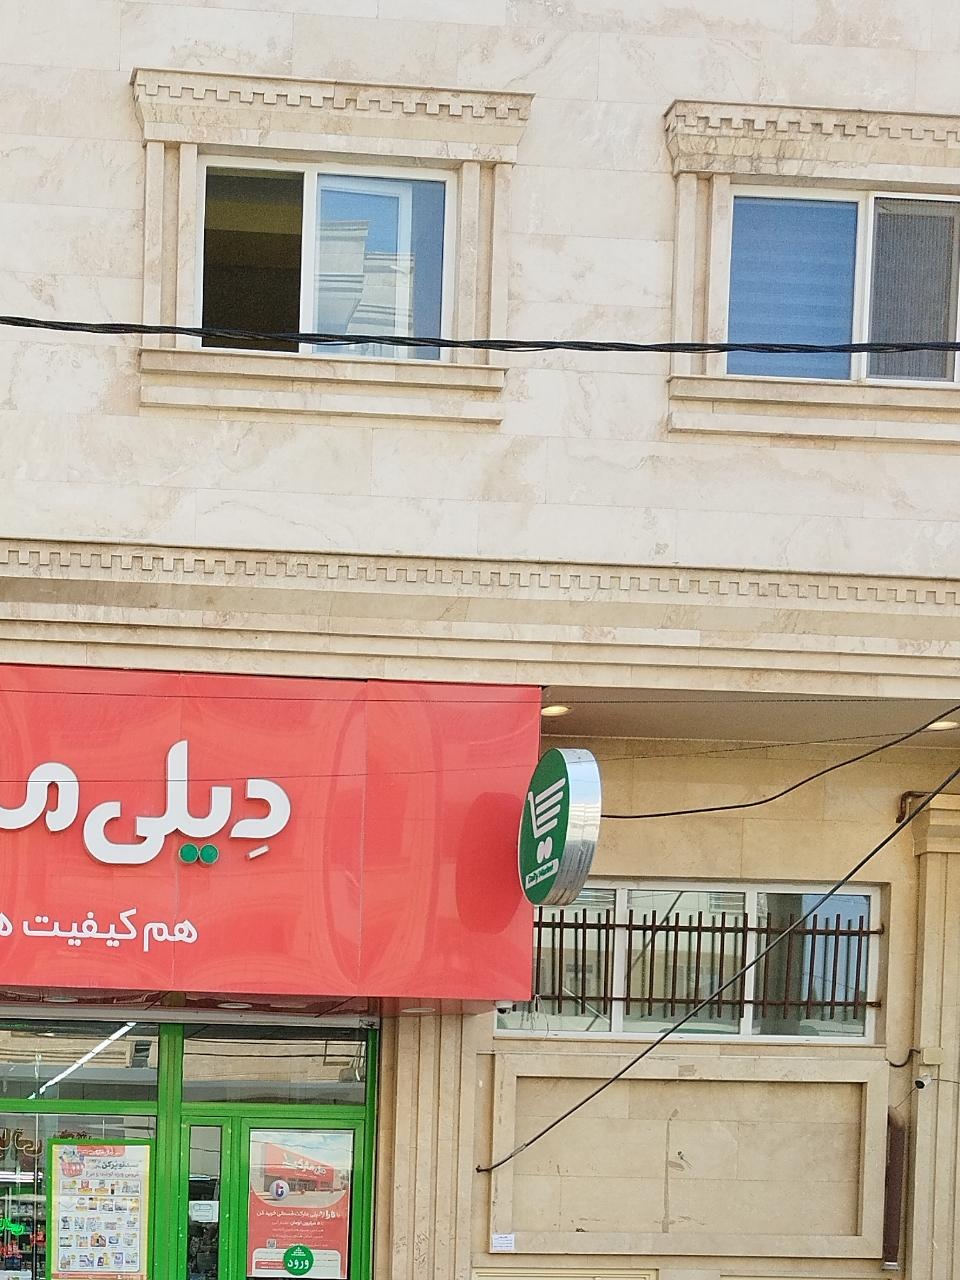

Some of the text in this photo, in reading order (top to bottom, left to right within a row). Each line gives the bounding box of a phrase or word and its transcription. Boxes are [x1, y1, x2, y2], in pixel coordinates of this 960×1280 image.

[22, 908, 137, 948] کیفیت
[143, 919, 198, 952] هم
[287, 1258, 310, 1270] ورود
